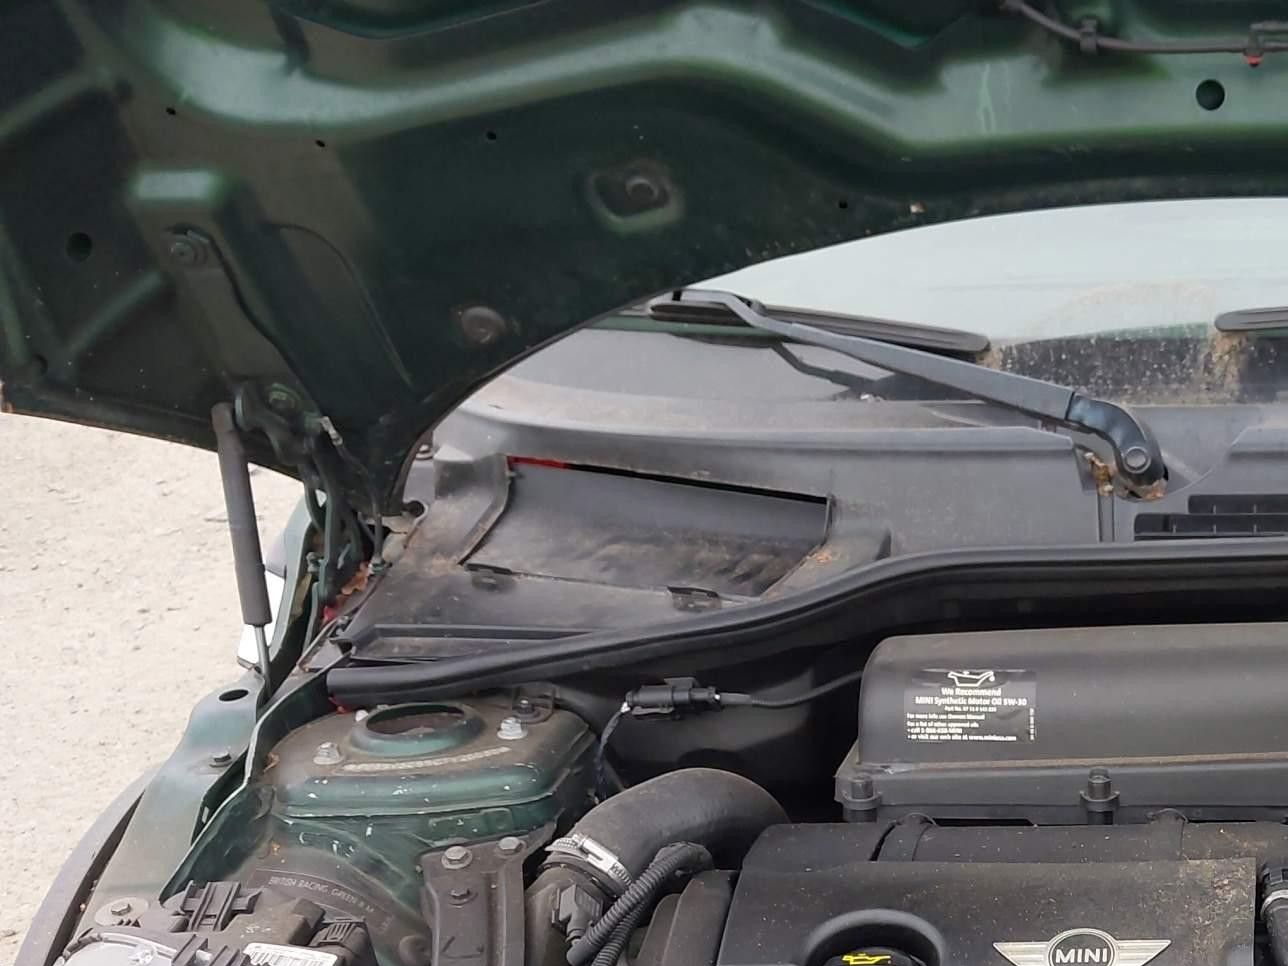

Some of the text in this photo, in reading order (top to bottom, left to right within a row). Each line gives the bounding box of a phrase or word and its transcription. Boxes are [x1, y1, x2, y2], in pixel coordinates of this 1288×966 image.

[941, 687, 1002, 697] We Recommend
[915, 696, 1028, 706] MINI Synthetic Motor Oil 5W-30
[297, 879, 329, 893] RACING
[330, 888, 357, 905] GREEN
[1055, 947, 1108, 964] MINI
